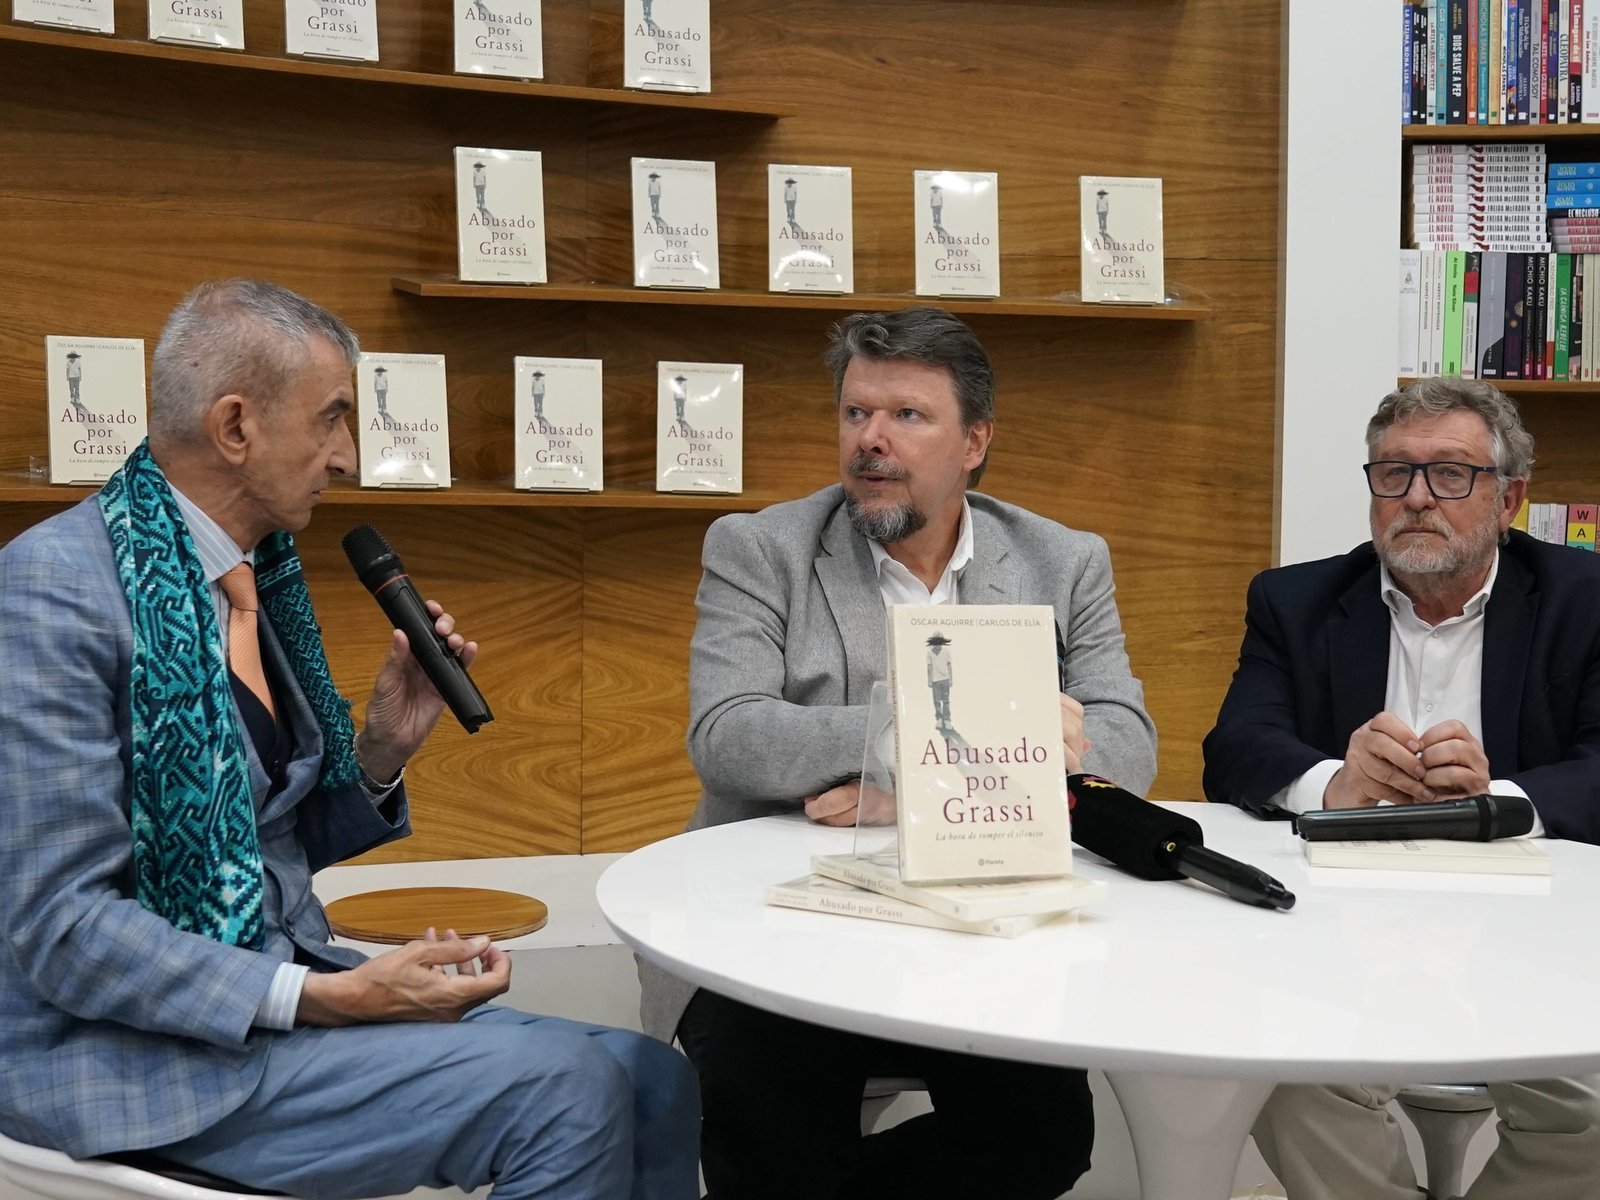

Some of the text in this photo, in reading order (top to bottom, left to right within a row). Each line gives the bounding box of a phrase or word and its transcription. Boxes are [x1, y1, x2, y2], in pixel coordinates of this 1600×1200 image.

[171, 1, 223, 20] Grassi
[320, 7, 345, 18] por
[464, 8, 533, 26] Abusado
[307, 16, 358, 34] Grassi
[488, 26, 511, 37] por
[634, 24, 701, 41] Abusado
[475, 35, 523, 52] Grassi
[657, 42, 680, 52] por
[1452, 35, 1462, 51] DIOS
[644, 51, 691, 67] Grassi
[1452, 53, 1462, 75] SALVE
[1560, 34, 1568, 81] CLEOPATRA
[1451, 83, 1462, 97] PEP
[468, 213, 535, 229] Abusado
[492, 231, 514, 242] por
[643, 222, 709, 237] Abusado
[779, 227, 844, 241] Abusado
[666, 239, 688, 250] por
[925, 232, 990, 245] Abusado
[1092, 238, 1154, 252] Abusado
[480, 242, 527, 256] Grassi
[947, 248, 969, 259] por
[935, 258, 981, 272] Grassi
[1112, 255, 1134, 266] por
[1100, 265, 1146, 279] Grassi
[1538, 257, 1546, 284] MICHIO
[61, 408, 137, 424] Abusado
[370, 418, 439, 432] Abusado
[526, 421, 593, 437] Abusado
[88, 428, 113, 440] por
[667, 425, 733, 440] Abusado
[74, 440, 127, 455] Grassi
[393, 436, 417, 447] por
[549, 440, 571, 450] por
[689, 443, 712, 453] por
[381, 446, 430, 460] Gssi
[536, 450, 583, 464] Grassi
[677, 453, 723, 467] Grassi
[910, 617, 1041, 627] OSCAR AGUIRRE CARLOS DE ELÍA
[920, 736, 1047, 765] Abusado
[965, 775, 1008, 798] por
[943, 795, 1034, 824] Grassi
[936, 830, 1043, 841] La hora de romper el silencio
[819, 898, 856, 911] Abusado
[858, 905, 873, 915] por
[875, 906, 903, 918] Grassi
